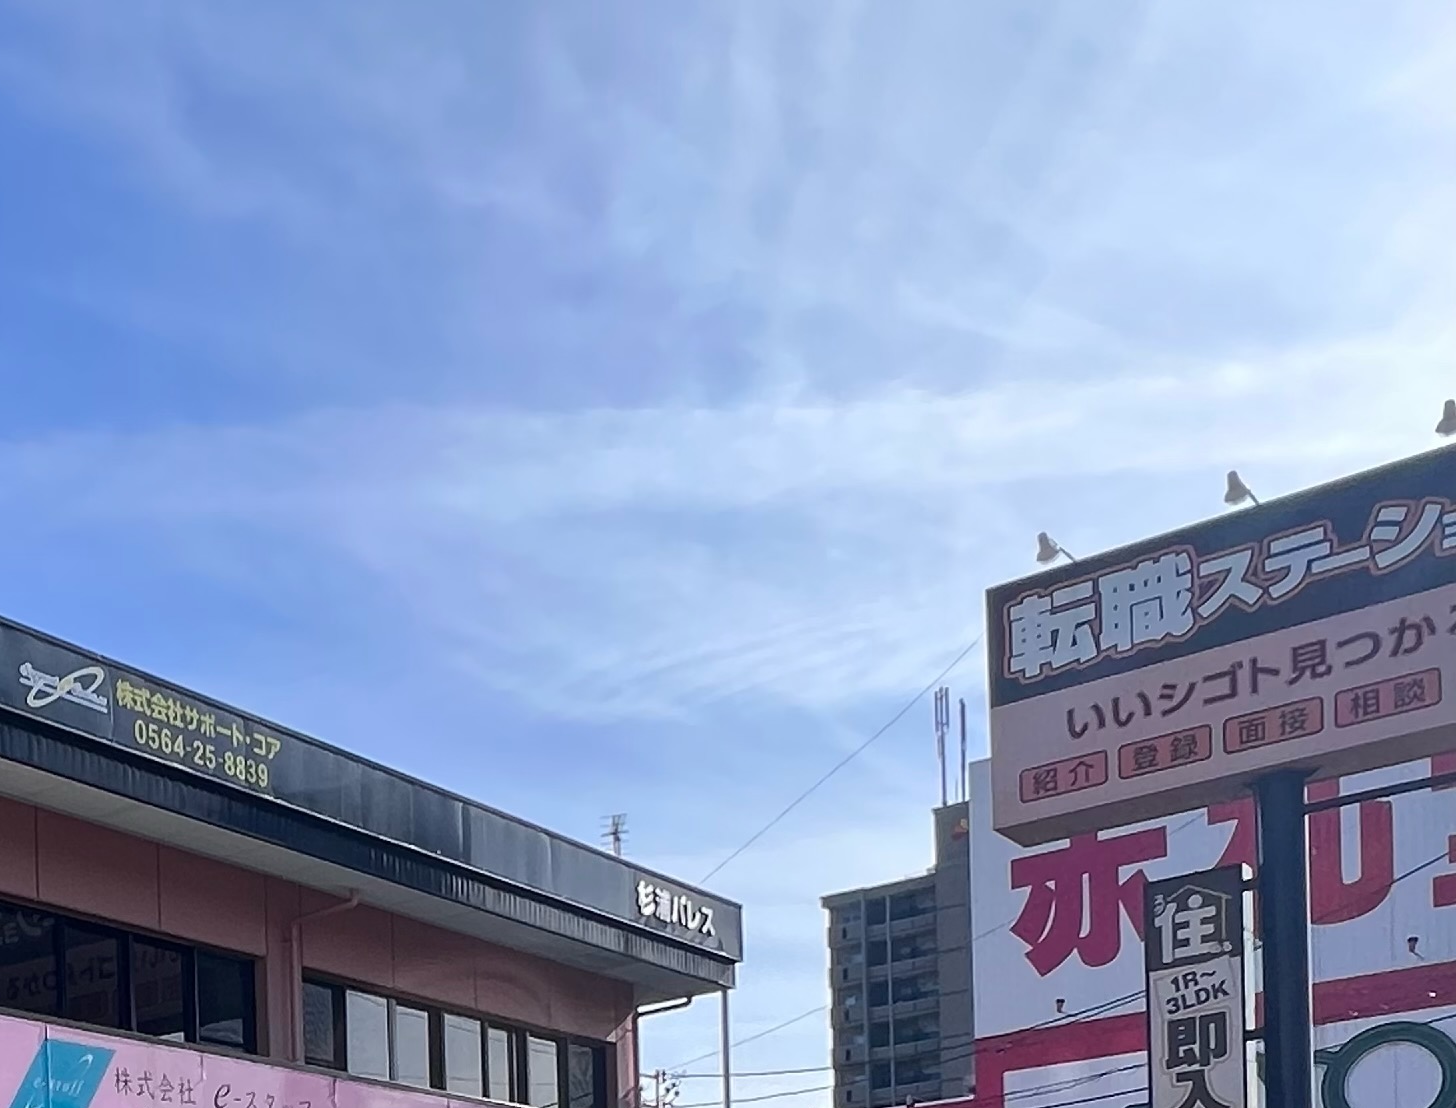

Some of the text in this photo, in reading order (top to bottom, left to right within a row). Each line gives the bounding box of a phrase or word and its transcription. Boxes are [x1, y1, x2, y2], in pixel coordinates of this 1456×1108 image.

[1008, 501, 1456, 679] 転職ステーシ
[1066, 603, 1456, 740] いいシゴト見つか
[134, 719, 269, 788] 0564-25-8839
[1032, 678, 1426, 795] 紹介 登録 面接 相談
[1166, 980, 1230, 1015] 3LDK
[115, 1067, 197, 1105] 株式会社
